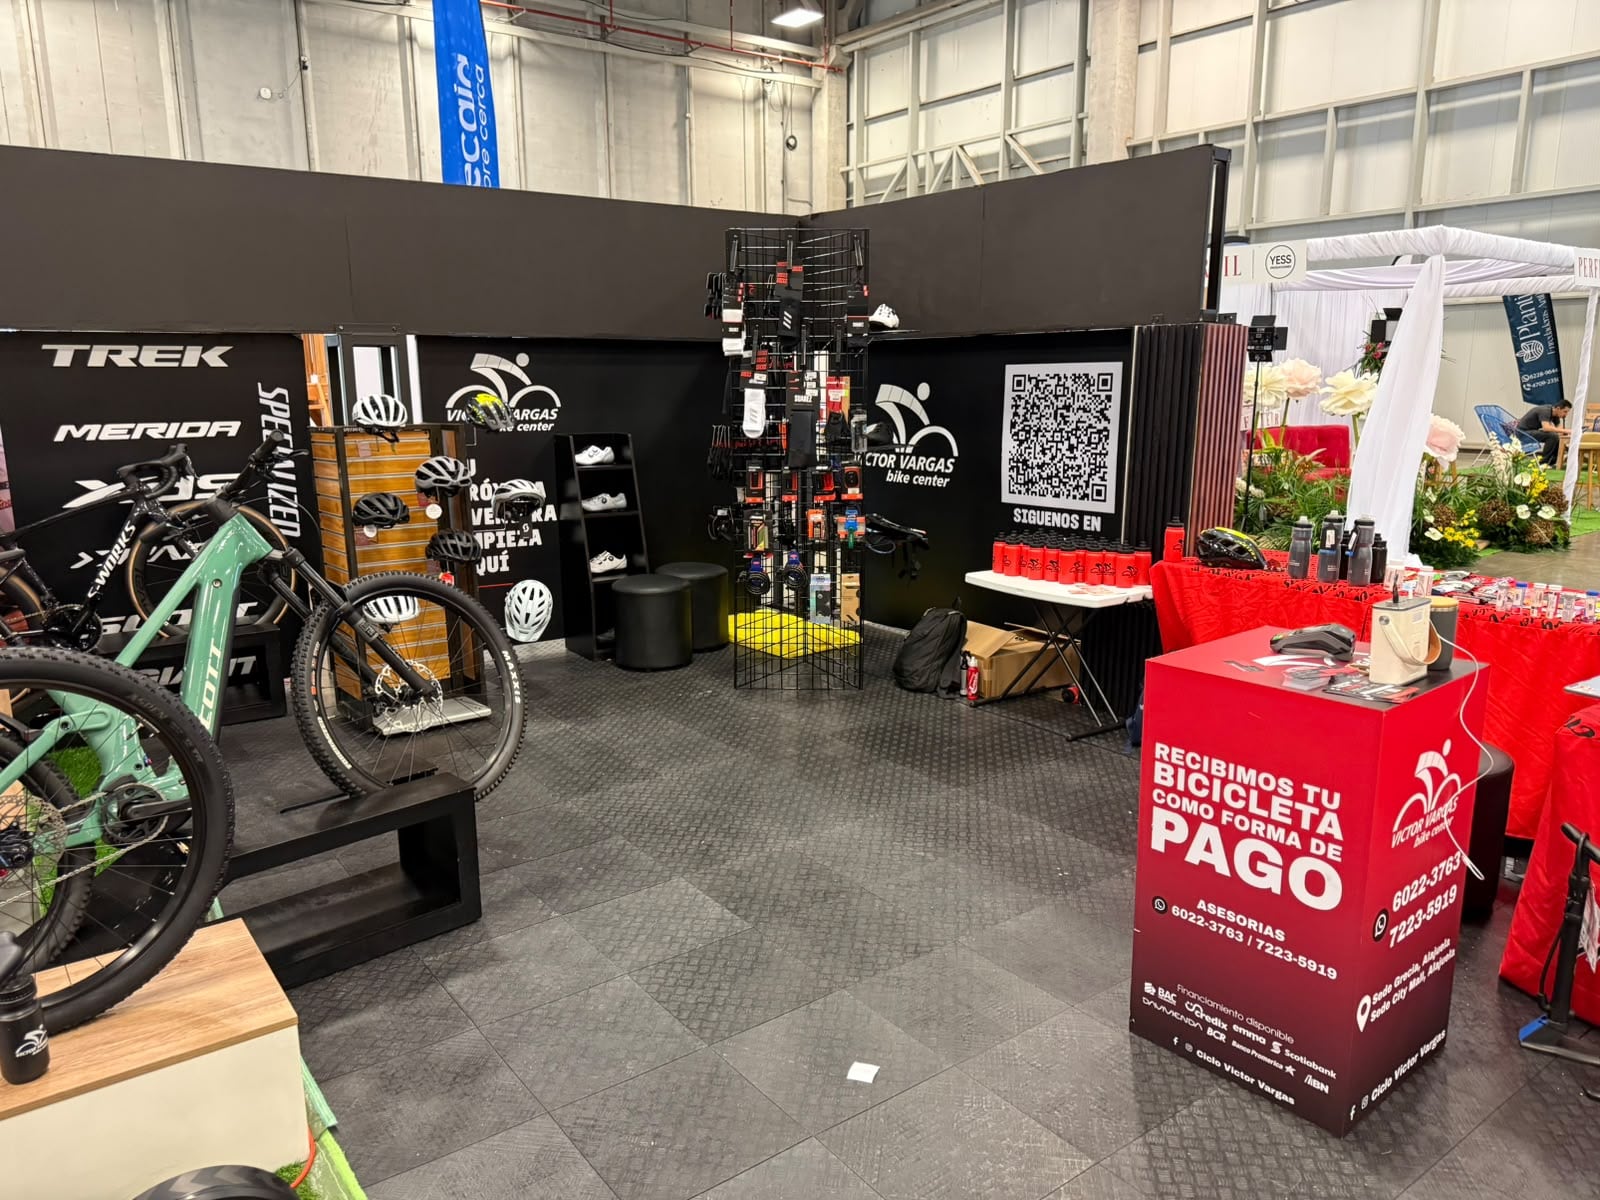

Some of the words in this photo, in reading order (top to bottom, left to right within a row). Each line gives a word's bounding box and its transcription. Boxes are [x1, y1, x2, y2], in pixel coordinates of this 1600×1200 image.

[474, 63, 489, 141] cerca
[1269, 254, 1292, 265] YESS
[1578, 257, 1600, 279] PERF
[41, 344, 234, 368] TREK
[53, 421, 242, 442] MERIDA
[512, 408, 559, 421] ARGAS
[517, 421, 554, 432] center
[886, 469, 910, 484] bike
[913, 474, 950, 487] center
[900, 455, 955, 473] VARGAS
[1013, 508, 1080, 529] SIGUENOS
[1083, 515, 1102, 532] EN
[88, 520, 136, 599] S-WORKS
[476, 550, 510, 576] QUÍ
[199, 640, 222, 731] COTT
[1155, 742, 1294, 797] RECIBIMOS
[1303, 783, 1341, 811] TU
[1153, 761, 1344, 841] BICICLETA
[1152, 789, 1215, 821] COMO
[1221, 810, 1302, 850] FORMA
[1310, 837, 1343, 863] DE
[1391, 817, 1424, 849] VICTOR
[1413, 828, 1430, 849] bike
[1151, 806, 1343, 912] PAGO
[1392, 850, 1461, 912] 6022-3763
[1196, 899, 1286, 942] ASESORIAS
[1389, 884, 1458, 949] 7223-5919
[1171, 905, 1244, 943] 6022-3763
[1256, 939, 1338, 980] 7223-5919
[1177, 984, 1244, 1021] Financiamiento
[1246, 1016, 1295, 1044] disponible
[1370, 1002, 1390, 1022] Sede
[1392, 987, 1408, 1006] City
[1372, 985, 1392, 1005] Sede
[1158, 987, 1177, 1003] BAC
[1232, 1024, 1266, 1045] emma
[1284, 1049, 1337, 1079] Scotiabank
[1207, 1026, 1227, 1043] BCR
[1196, 1049, 1221, 1068] Ciclo
[1223, 1062, 1255, 1085] Victor
[1257, 1079, 1295, 1105] Vargas
[1371, 1078, 1393, 1102] Ciclo
[1394, 1052, 1419, 1081] Victor
[1420, 1030, 1446, 1057] Vargas
